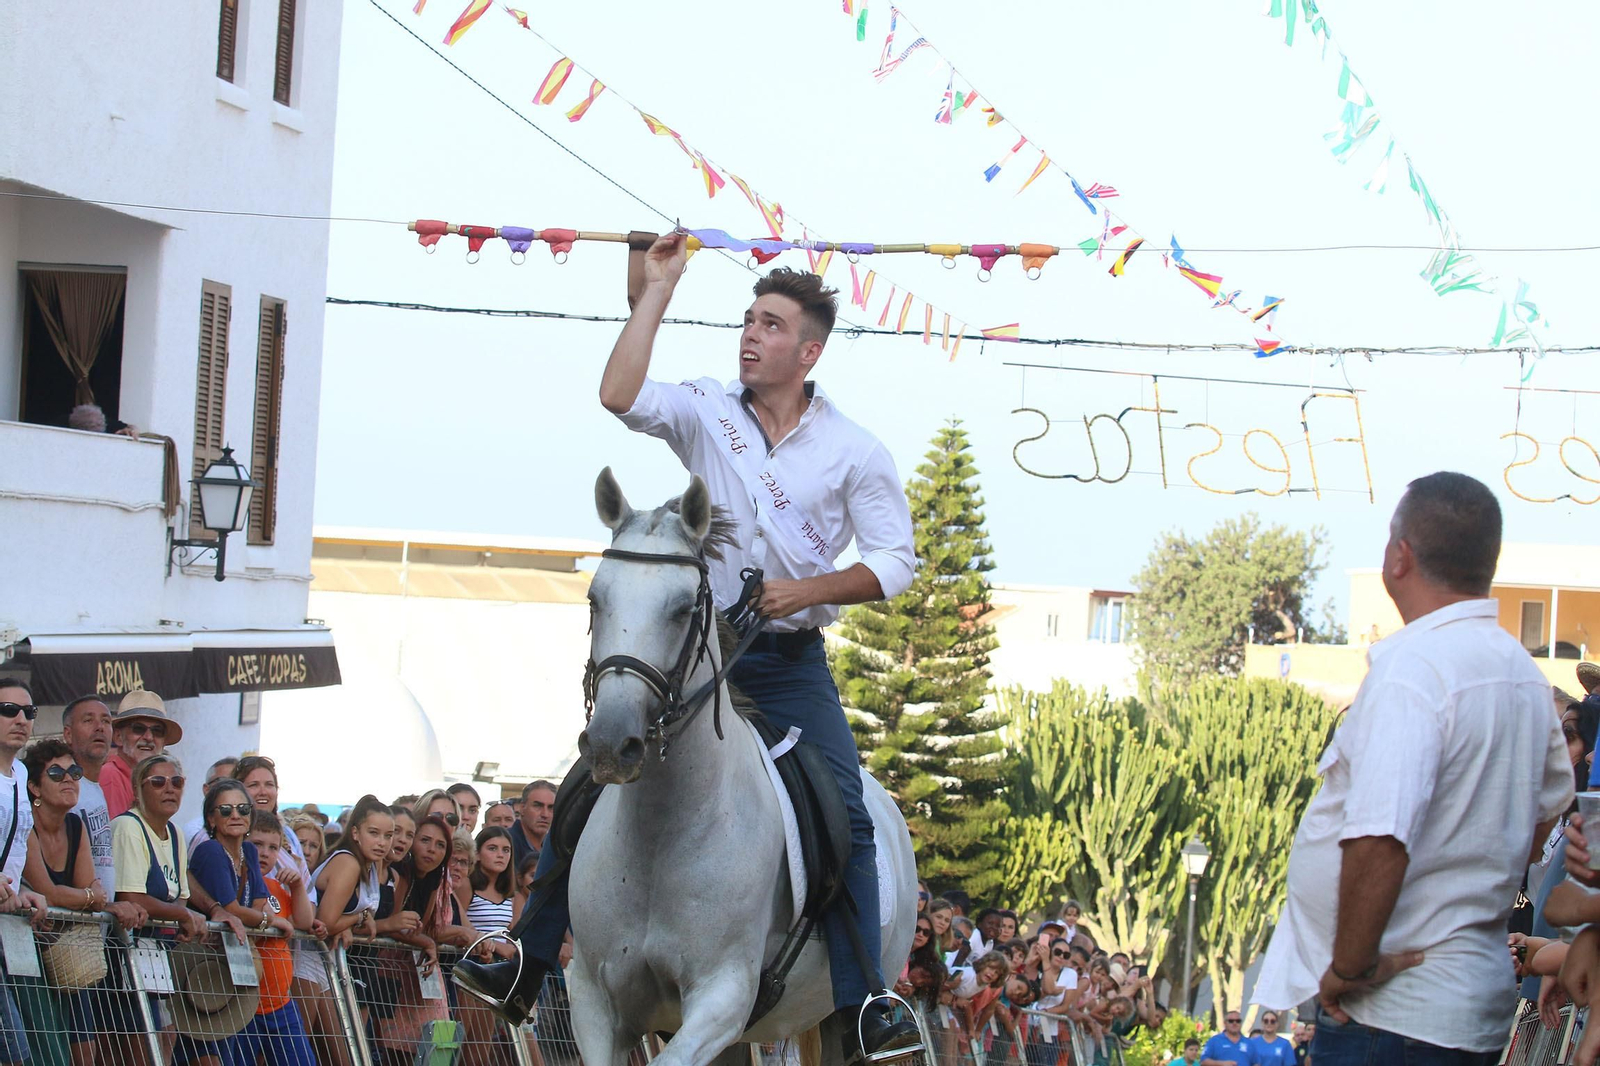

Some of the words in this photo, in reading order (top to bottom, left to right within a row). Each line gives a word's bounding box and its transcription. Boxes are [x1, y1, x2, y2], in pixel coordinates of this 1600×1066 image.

[718, 417, 748, 455] Prior
[759, 471, 791, 510] Perez
[801, 521, 830, 556] Maria
[96, 660, 145, 695] AROMA
[228, 654, 261, 686] CAFE
[269, 653, 307, 684] COPAS
